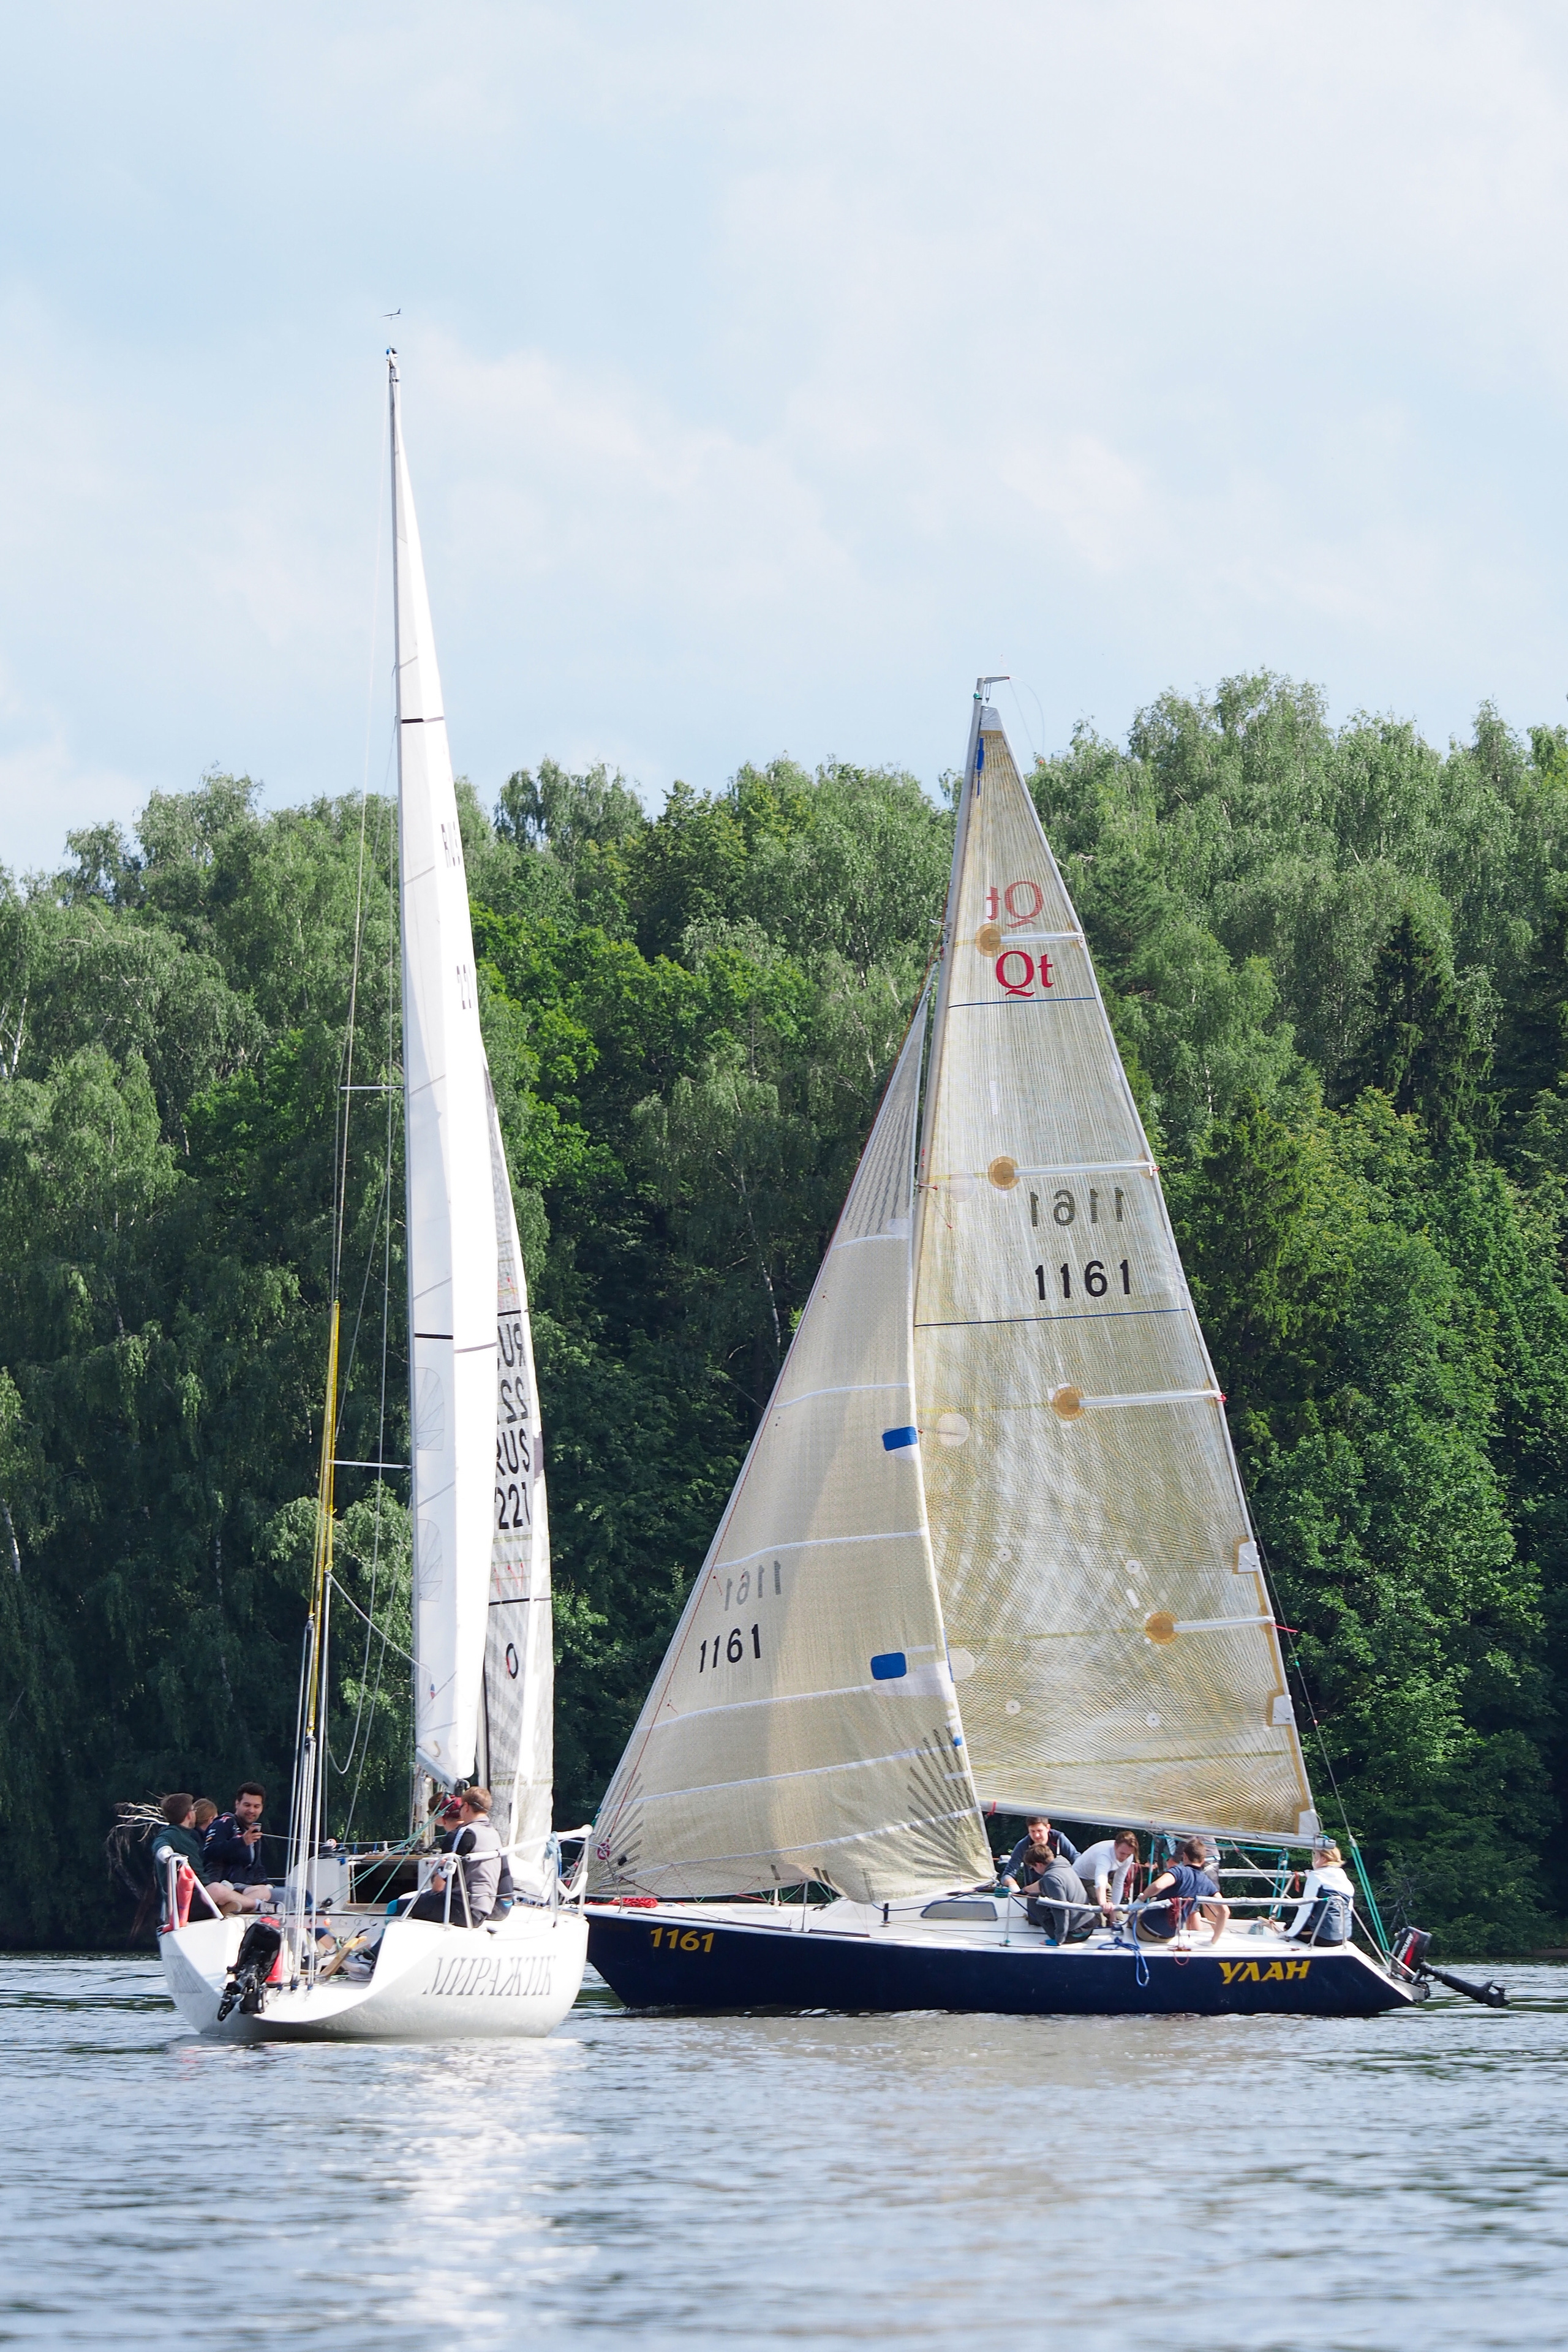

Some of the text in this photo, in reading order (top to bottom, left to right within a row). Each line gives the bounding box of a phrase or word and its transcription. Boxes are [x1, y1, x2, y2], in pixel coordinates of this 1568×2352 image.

[996, 951, 1054, 997] Qt
[1035, 1259, 1130, 1300] 1161
[494, 1482, 530, 1529] 221
[699, 1623, 761, 1673] 1161
[650, 1927, 714, 1953] 1161
[1218, 1960, 1311, 1985] УЛАН
